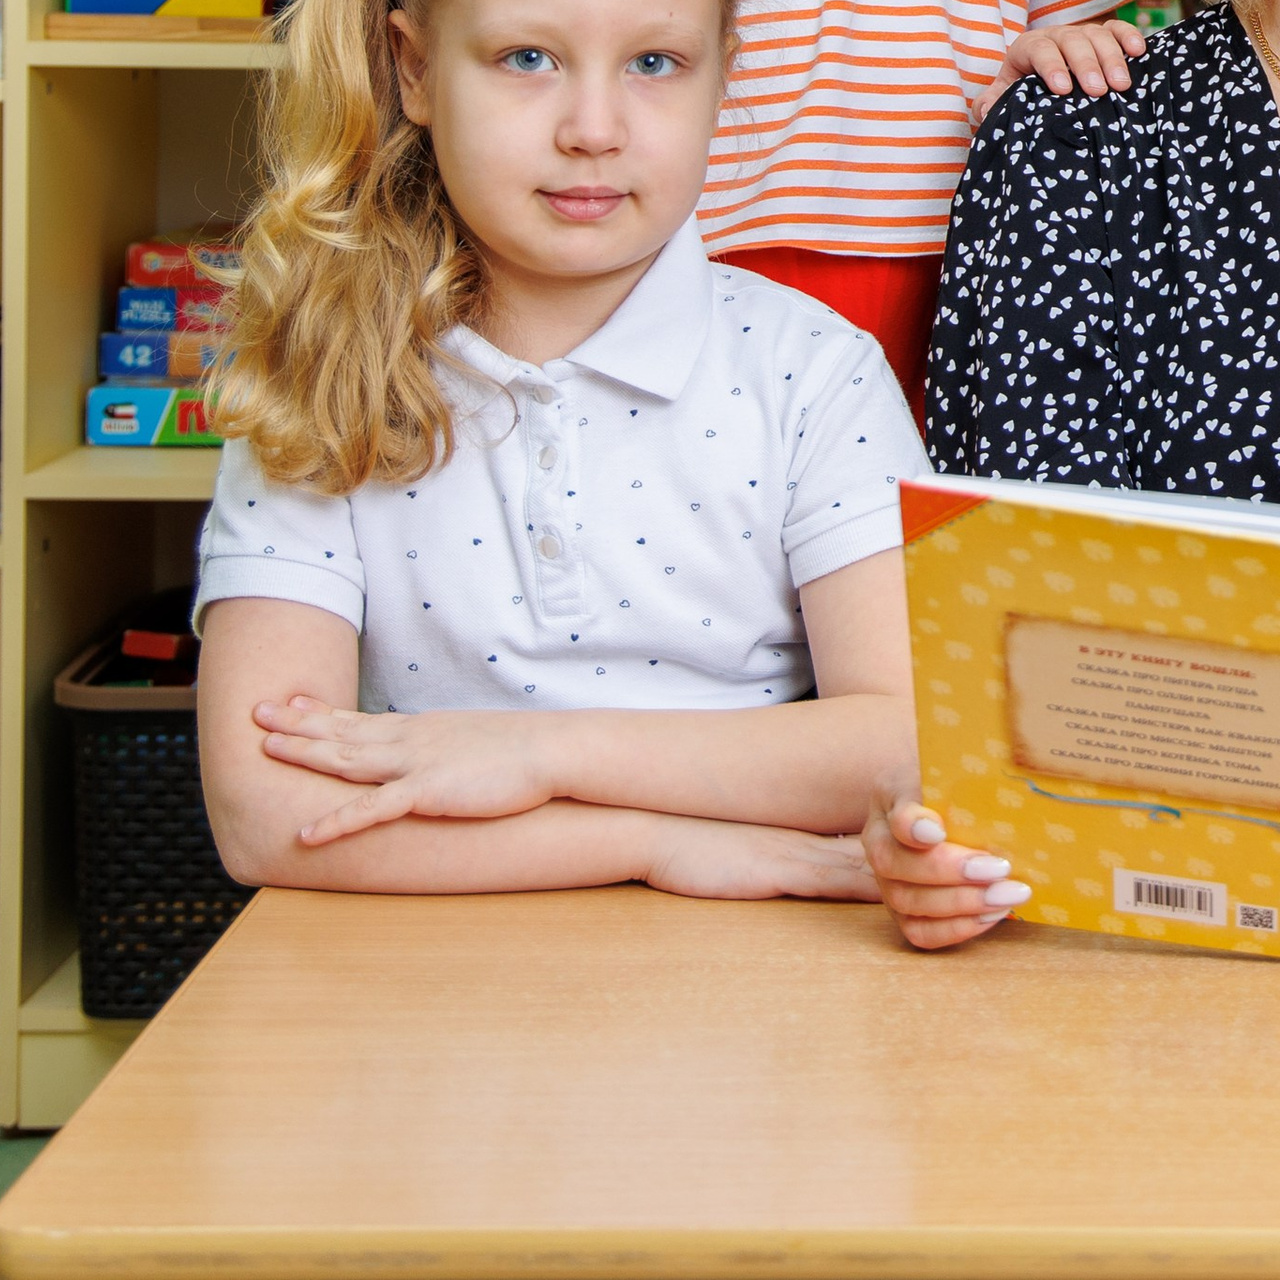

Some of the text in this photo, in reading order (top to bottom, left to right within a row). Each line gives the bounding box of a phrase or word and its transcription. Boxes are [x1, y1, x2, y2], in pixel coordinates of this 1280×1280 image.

[118, 344, 153, 367] 42
[1078, 644, 1090, 654] В
[1095, 647, 1126, 659] ЭТУ
[1130, 652, 1185, 668] КНИГУ
[1077, 662, 1131, 678] СКАЗКА
[1132, 671, 1161, 683] ПРО
[1071, 676, 1125, 693] СКАЗКА
[1126, 685, 1155, 697] ПРО
[1046, 703, 1099, 719] СКАЗКА
[1101, 711, 1129, 723] ПРО
[1131, 716, 1192, 733] МИСТЕРА
[1065, 721, 1118, 737] СКАЗКА
[1119, 729, 1148, 740] ПРО
[1150, 734, 1206, 750] МИССИС
[1049, 747, 1102, 764] СКАЗКА
[1104, 757, 1131, 768] ПРО
[1076, 737, 1129, 753] СКАЗКА
[1130, 746, 1158, 758] ПРО
[1223, 760, 1262, 773] ТОМА
